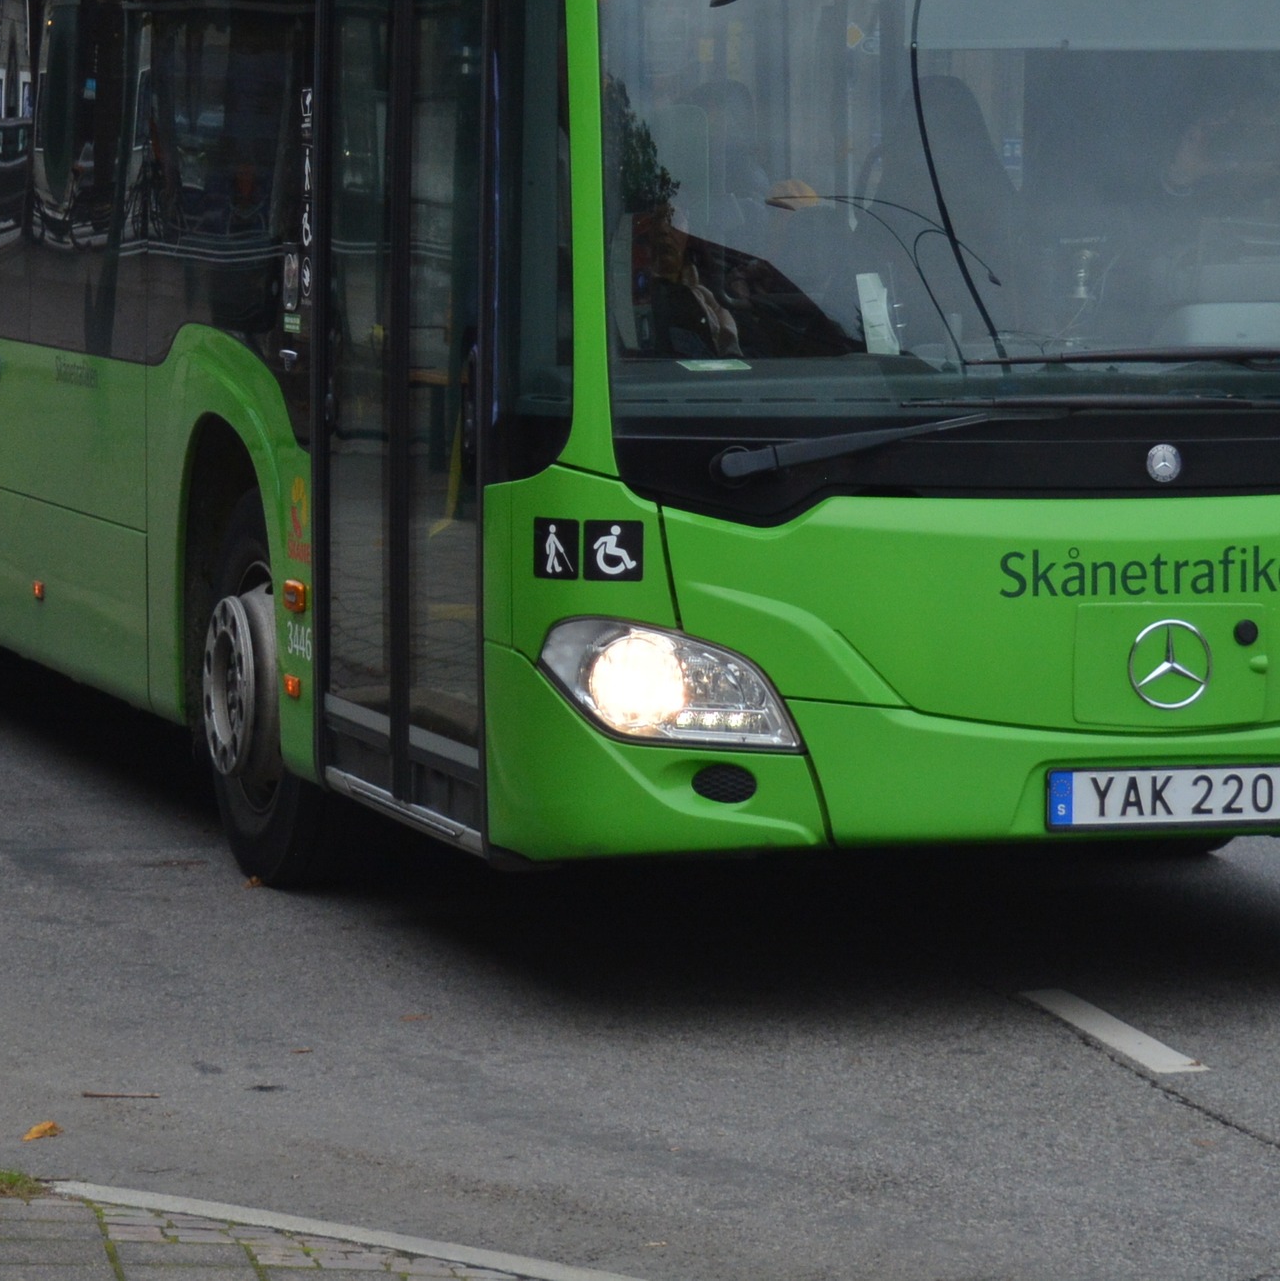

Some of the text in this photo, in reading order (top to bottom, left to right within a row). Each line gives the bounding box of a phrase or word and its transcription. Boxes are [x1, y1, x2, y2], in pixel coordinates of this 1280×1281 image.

[287, 620, 312, 662] 3446
[1057, 773, 1274, 818] S YAK 220
